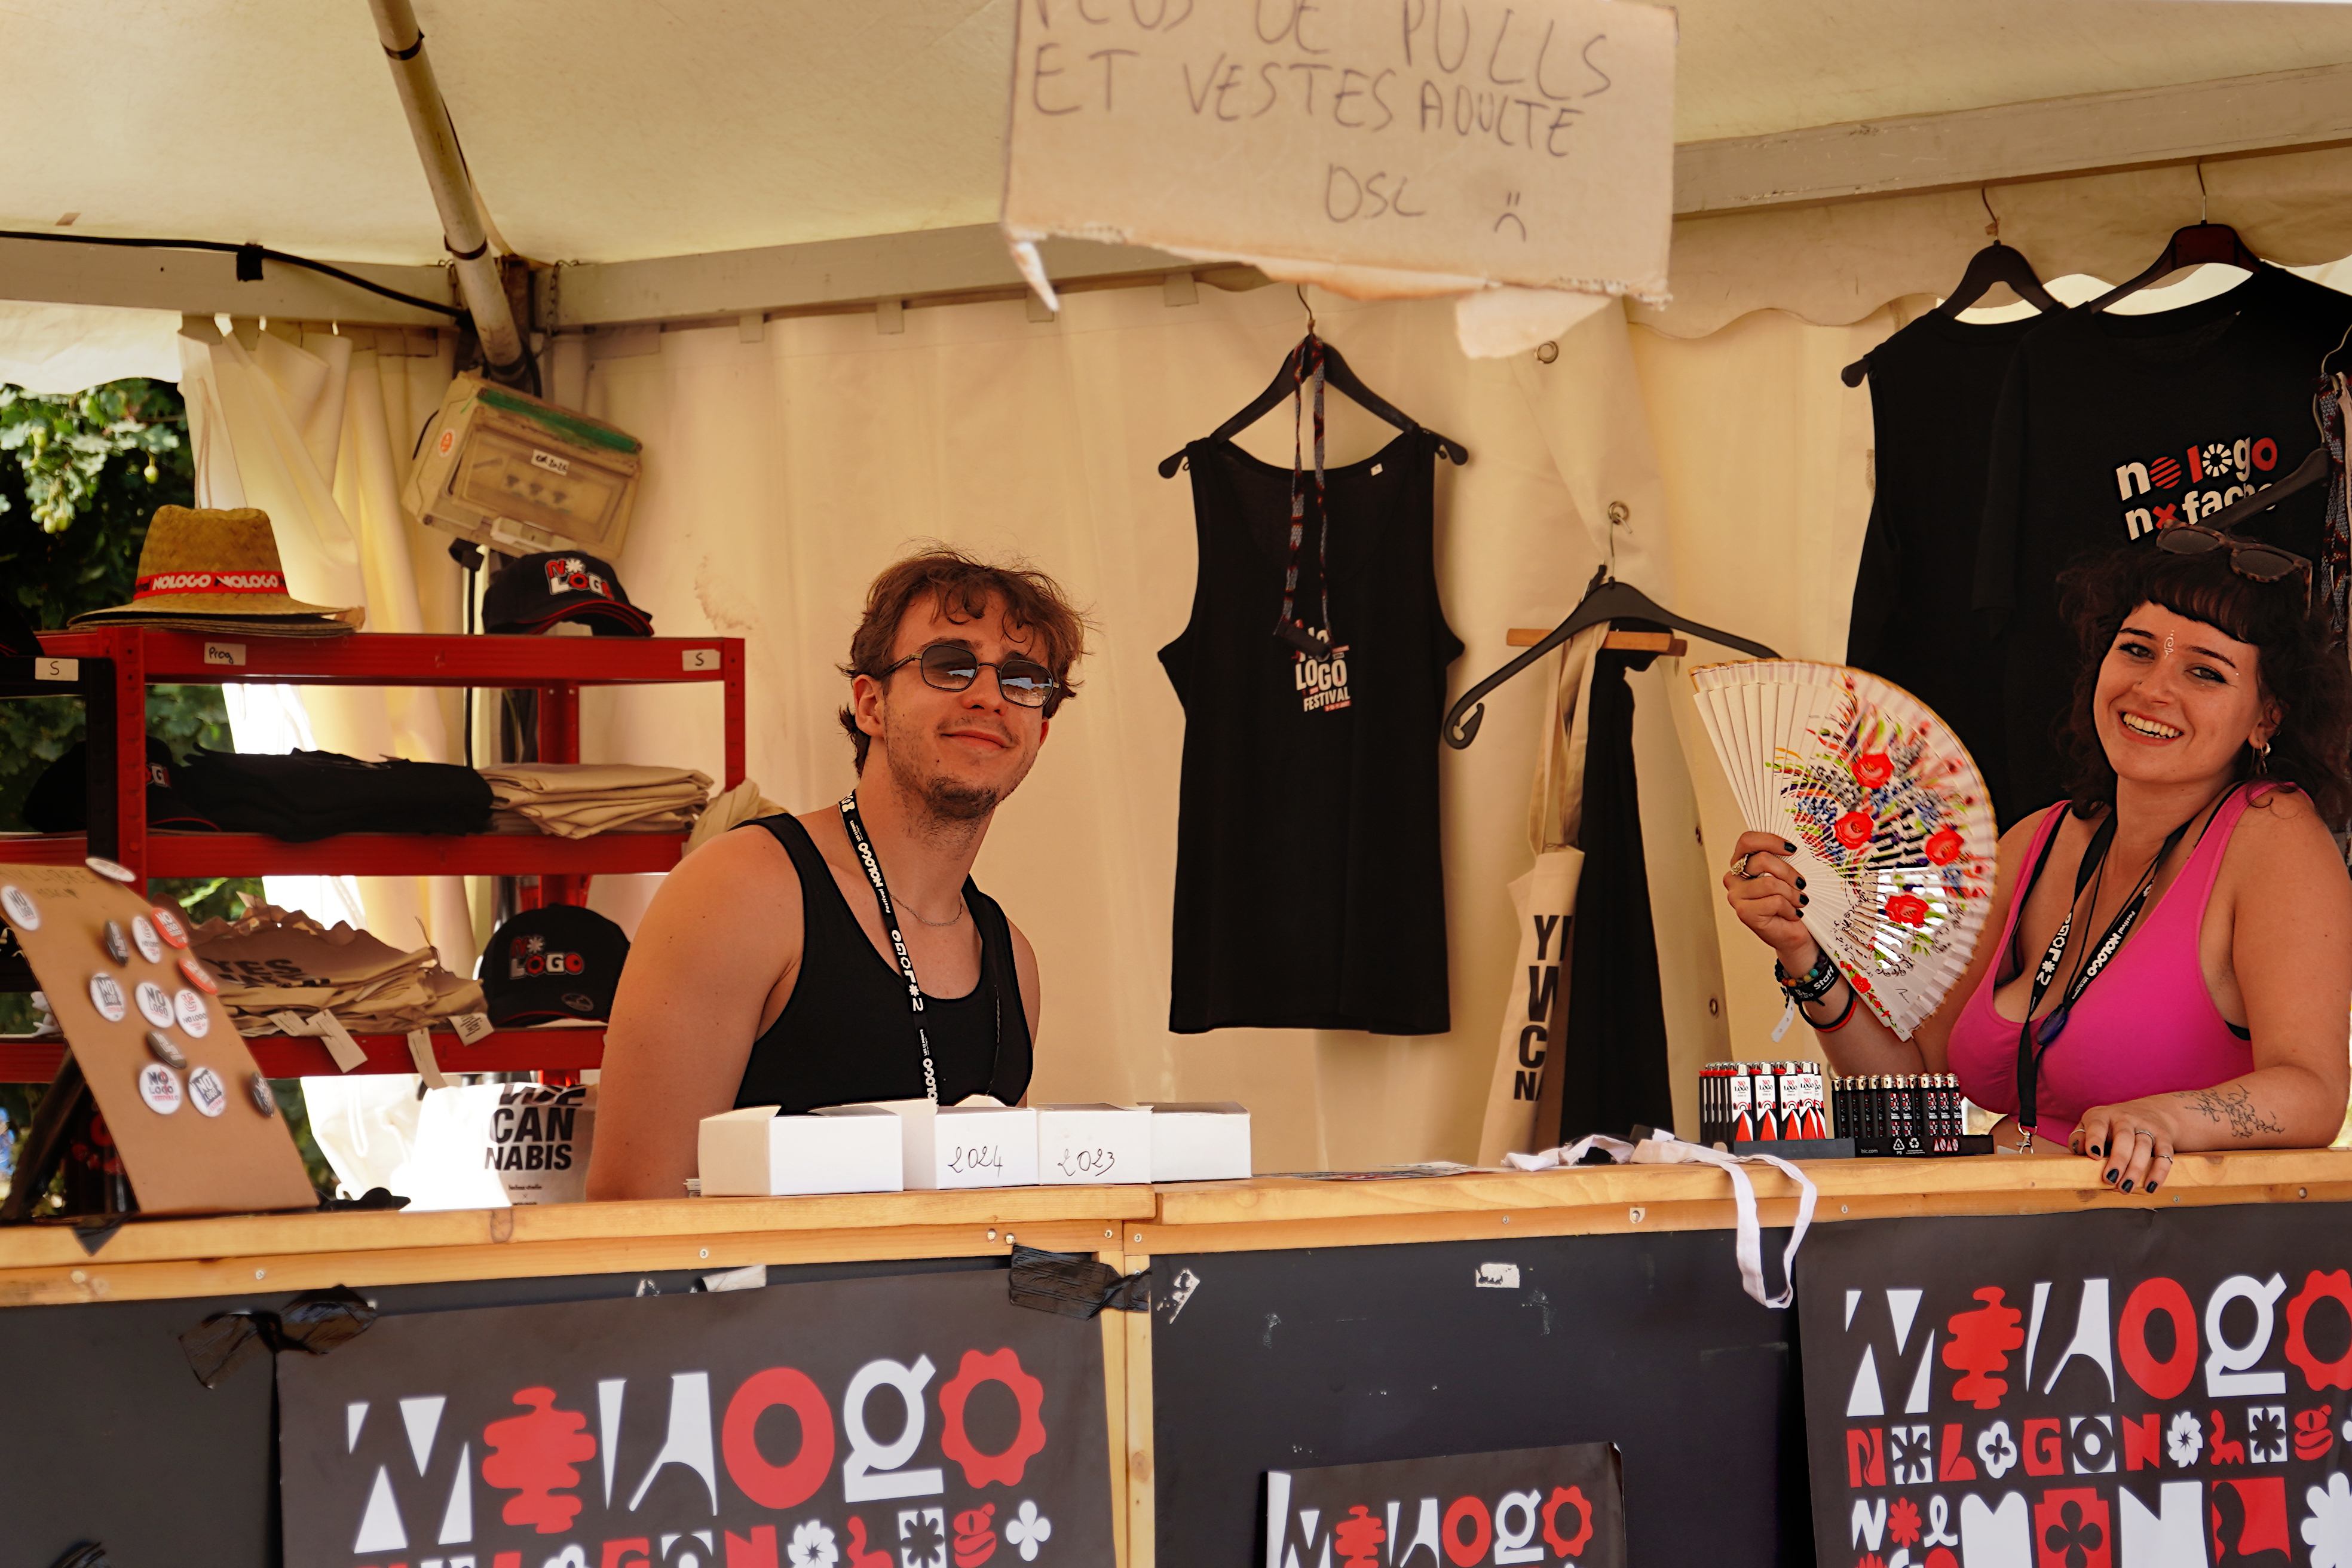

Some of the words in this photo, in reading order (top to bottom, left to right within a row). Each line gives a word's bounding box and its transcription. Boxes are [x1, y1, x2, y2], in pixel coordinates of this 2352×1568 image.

[1033, 42, 1141, 116] ET
[1182, 53, 1397, 133] VESTES
[152, 574, 212, 591] NOLOGO
[50, 660, 60, 676] S
[695, 652, 705, 667] S
[1295, 659, 1348, 691] LOGO
[1303, 686, 1352, 712] FESTIVAL
[858, 842, 884, 887] NOLOGO
[878, 888, 891, 914] Festival
[2117, 910, 2136, 935] Festival
[510, 953, 584, 978] LOGO
[2087, 932, 2122, 976] NOLOGO
[200, 958, 304, 978] YES
[1813, 964, 1835, 990] Staff
[144, 986, 166, 1008] NO
[146, 1071, 169, 1086] NO
[489, 1107, 576, 1144] CAN
[485, 1144, 572, 1171] NABIS
[947, 1145, 1004, 1178] 2024
[1057, 1148, 1115, 1177] 2023
